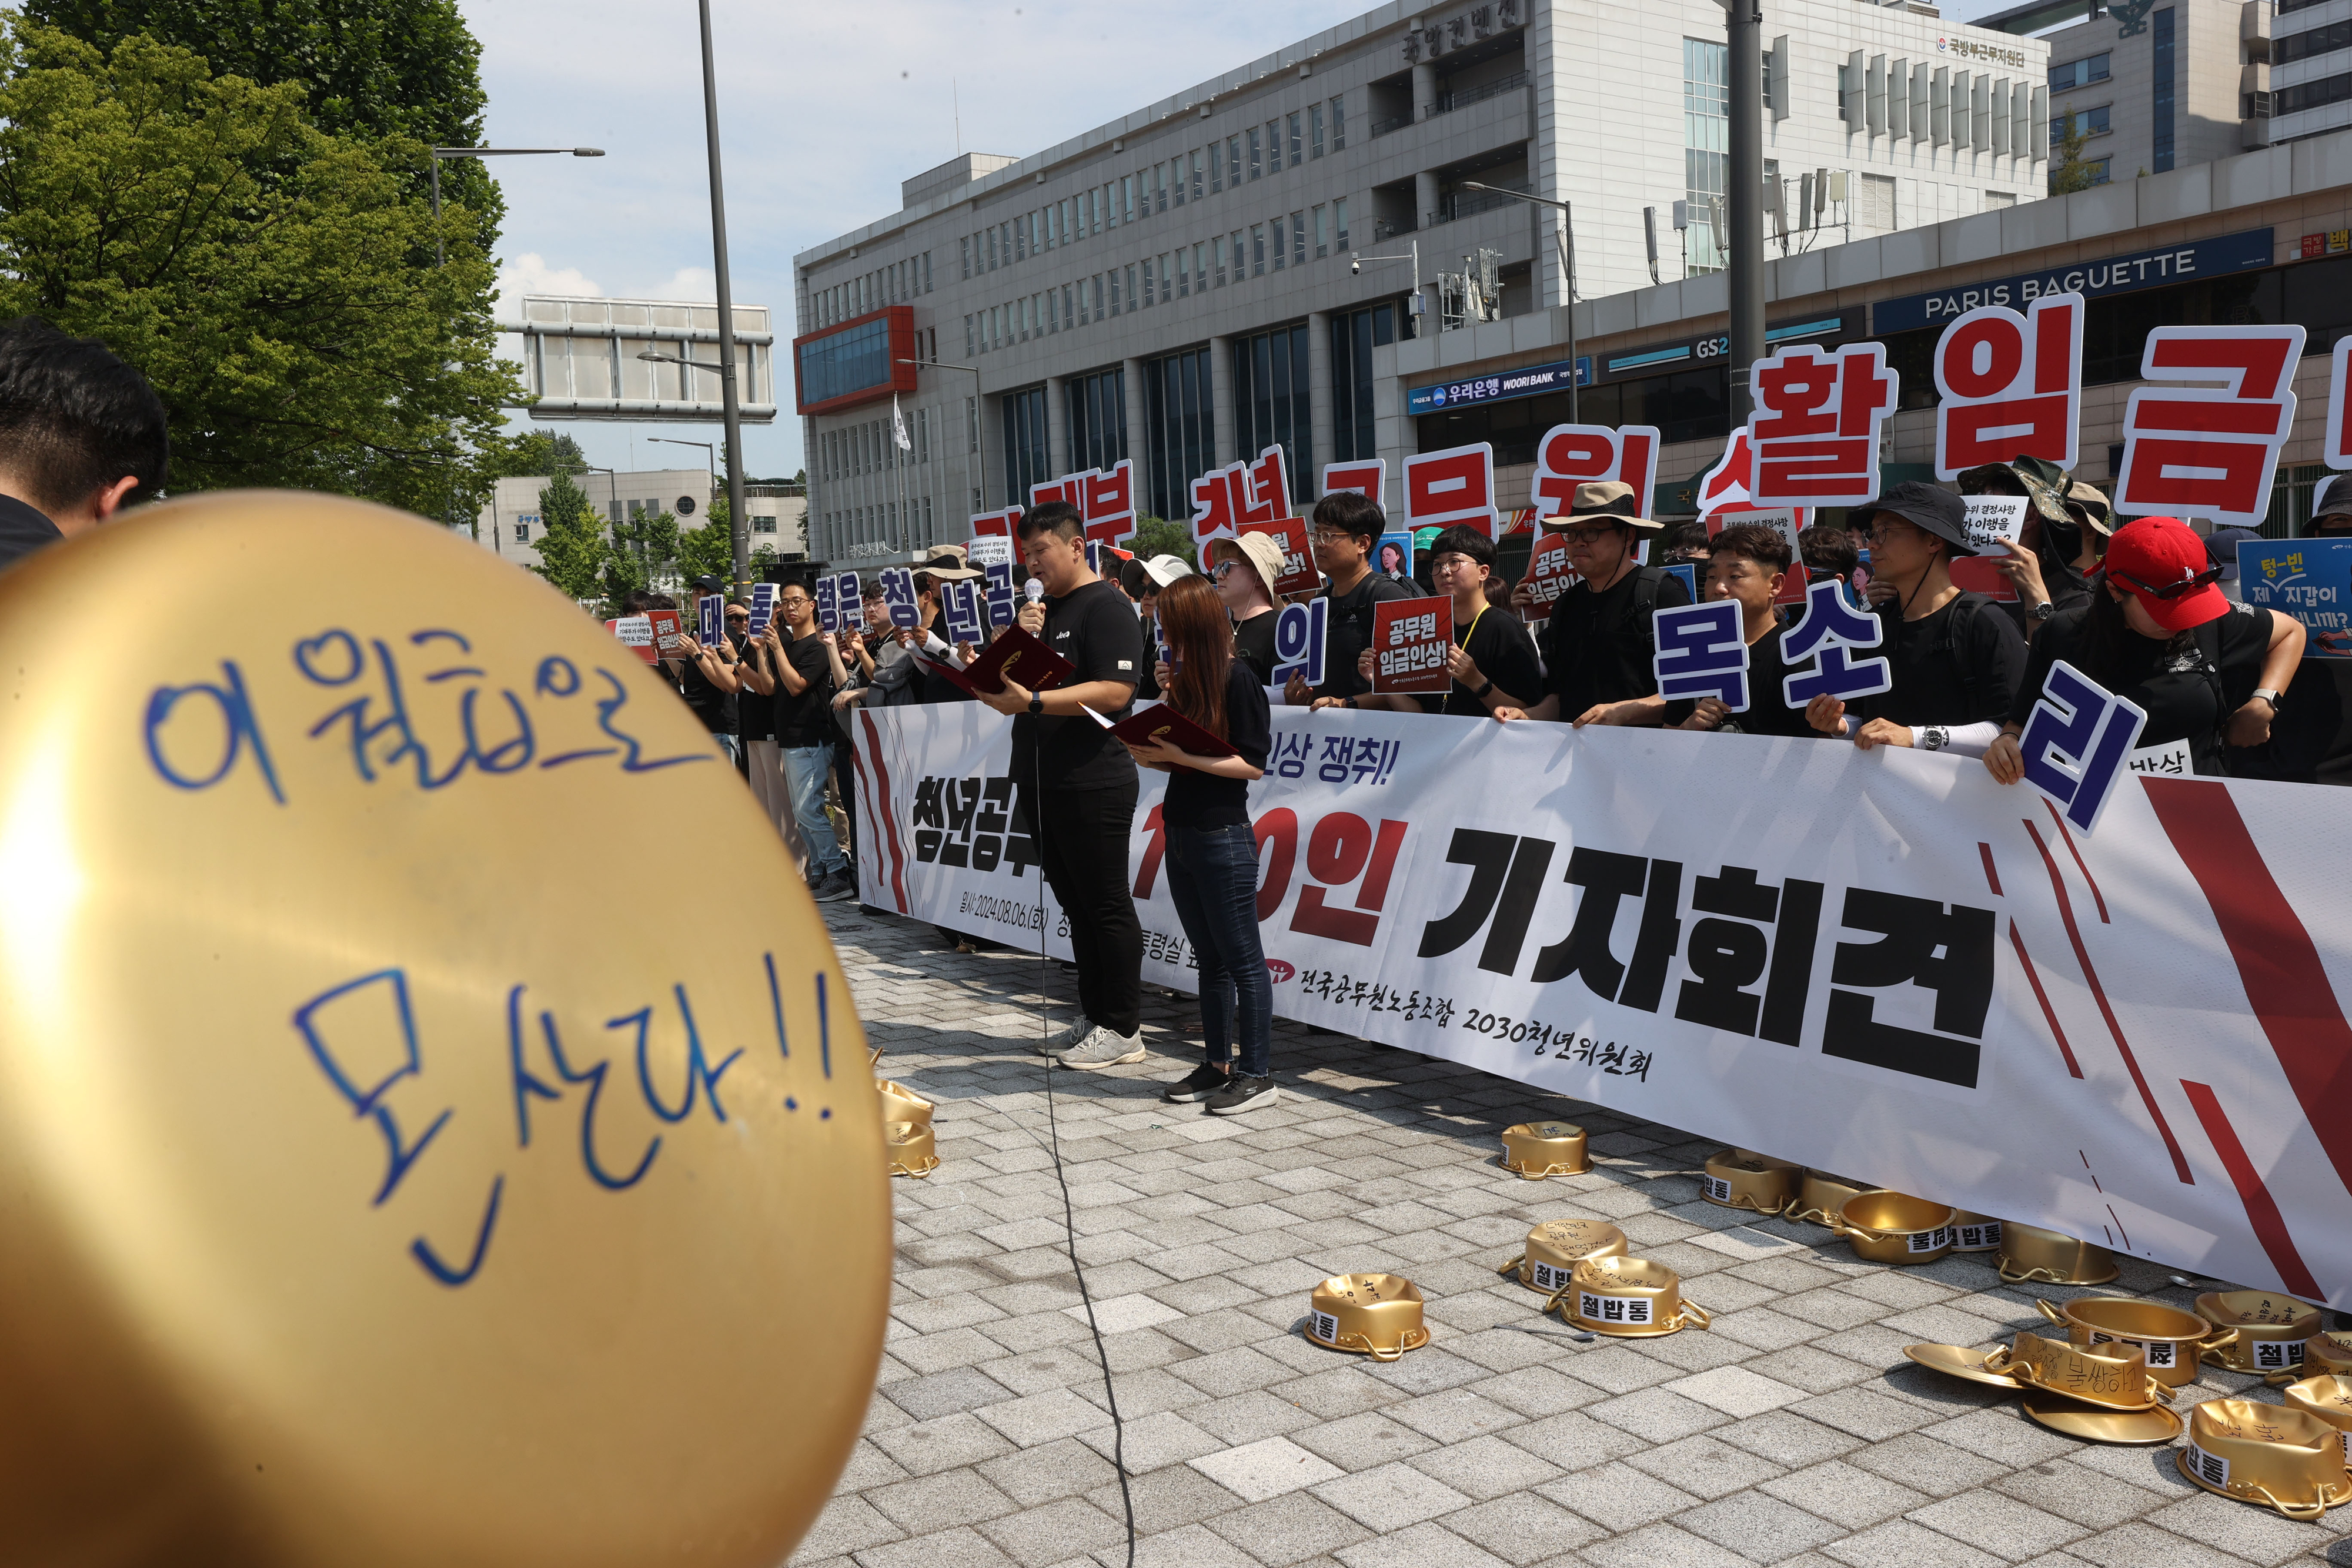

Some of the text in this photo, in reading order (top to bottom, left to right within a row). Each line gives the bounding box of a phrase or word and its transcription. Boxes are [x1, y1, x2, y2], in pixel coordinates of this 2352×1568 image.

[1949, 38, 2026, 68] 국방부근무지원단
[2303, 236, 2321, 245] 국방
[2303, 245, 2321, 255] 가든
[1926, 250, 2196, 319] PARIS BAGUETTE
[1697, 337, 1730, 359] GS2
[1449, 377, 1500, 402] 우리은행
[1503, 372, 1555, 390] WOORI BANK
[1943, 304, 2072, 470] 임
[1754, 352, 1887, 500] 활
[2124, 338, 2293, 514] 금
[1760, 517, 1788, 527] 결정사항
[1975, 517, 2010, 531] 이행을
[1981, 504, 2017, 515] 결정사항
[2184, 566, 2194, 580] LA
[749, 585, 773, 635] 통
[840, 574, 863, 631] 은
[881, 570, 920, 627] 청
[942, 583, 981, 644] 년
[986, 563, 1014, 627] 공
[2252, 586, 2337, 607] 제 지갑이
[656, 618, 676, 634] 공무원
[700, 597, 723, 646] 대
[1056, 630, 1071, 640] Jeep
[1389, 612, 1437, 646] 공무원
[1274, 601, 1324, 686] 의
[1379, 640, 1448, 677] 임금인상!
[1658, 606, 1745, 708] 목
[1784, 586, 1886, 704] 소
[143, 658, 287, 806] 이
[2020, 666, 2139, 832] 리
[1319, 735, 1401, 785] 쟁취!
[960, 891, 1049, 933] 일시: 2024.08.06.(화)
[1131, 801, 1997, 1089] 10인 기자회견
[1301, 969, 1653, 1084] 전국공무원노동조합 2030청년위원회
[1546, 1221, 1589, 1230] 대한민국
[1582, 1295, 1648, 1322] 철밥통
[2066, 1355, 2139, 1394] 불쌍하고
